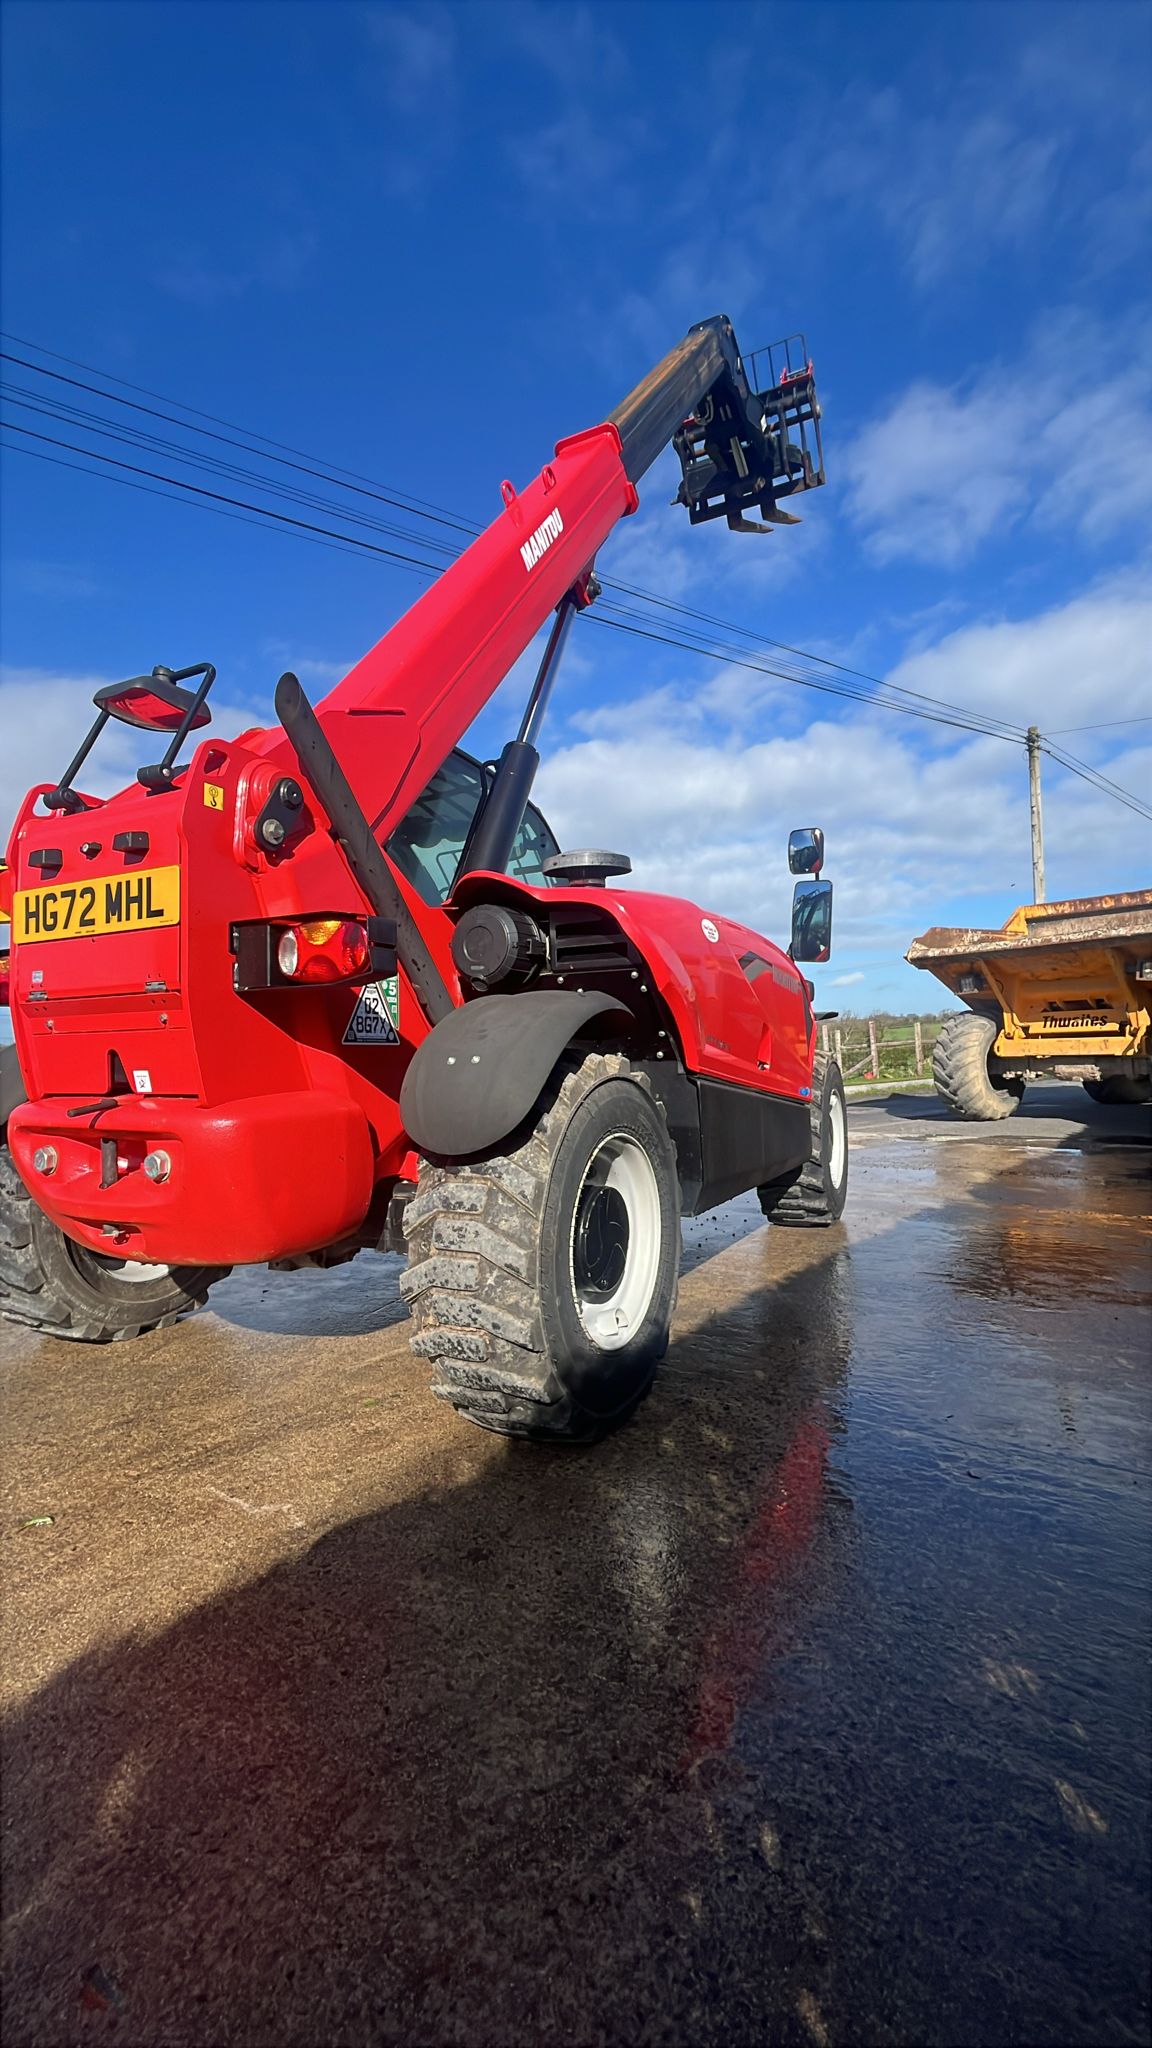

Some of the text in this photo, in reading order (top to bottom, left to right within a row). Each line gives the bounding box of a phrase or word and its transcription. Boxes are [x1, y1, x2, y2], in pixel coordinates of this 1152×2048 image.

[520, 507, 563, 572] MANITOU
[25, 877, 164, 935] HG72 MHL
[356, 1016, 387, 1034] BG7X
[1042, 1014, 1108, 1029] Thwaites
